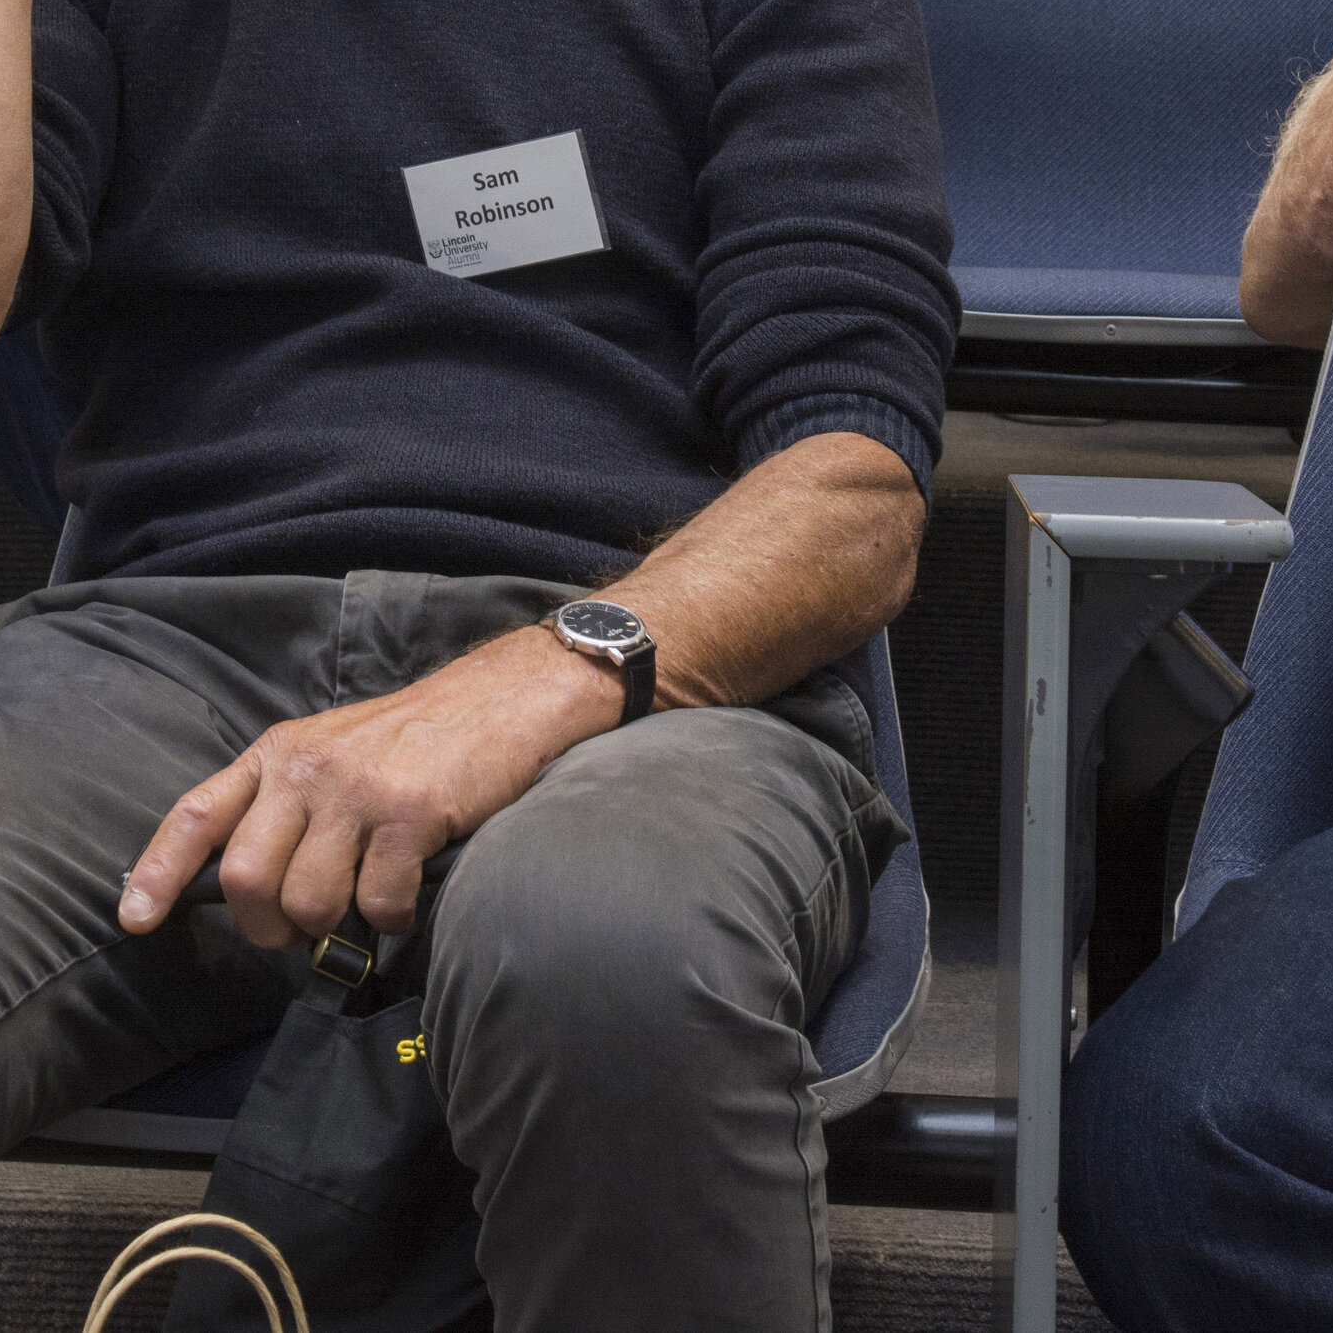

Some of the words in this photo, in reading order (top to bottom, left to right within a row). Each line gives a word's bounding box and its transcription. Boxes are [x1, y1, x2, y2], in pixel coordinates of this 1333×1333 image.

[473, 169, 519, 191] Sam
[455, 195, 554, 229] Robinson
[442, 233, 476, 247] Lincoln
[443, 241, 488, 257] University
[447, 253, 481, 265] Alumni
